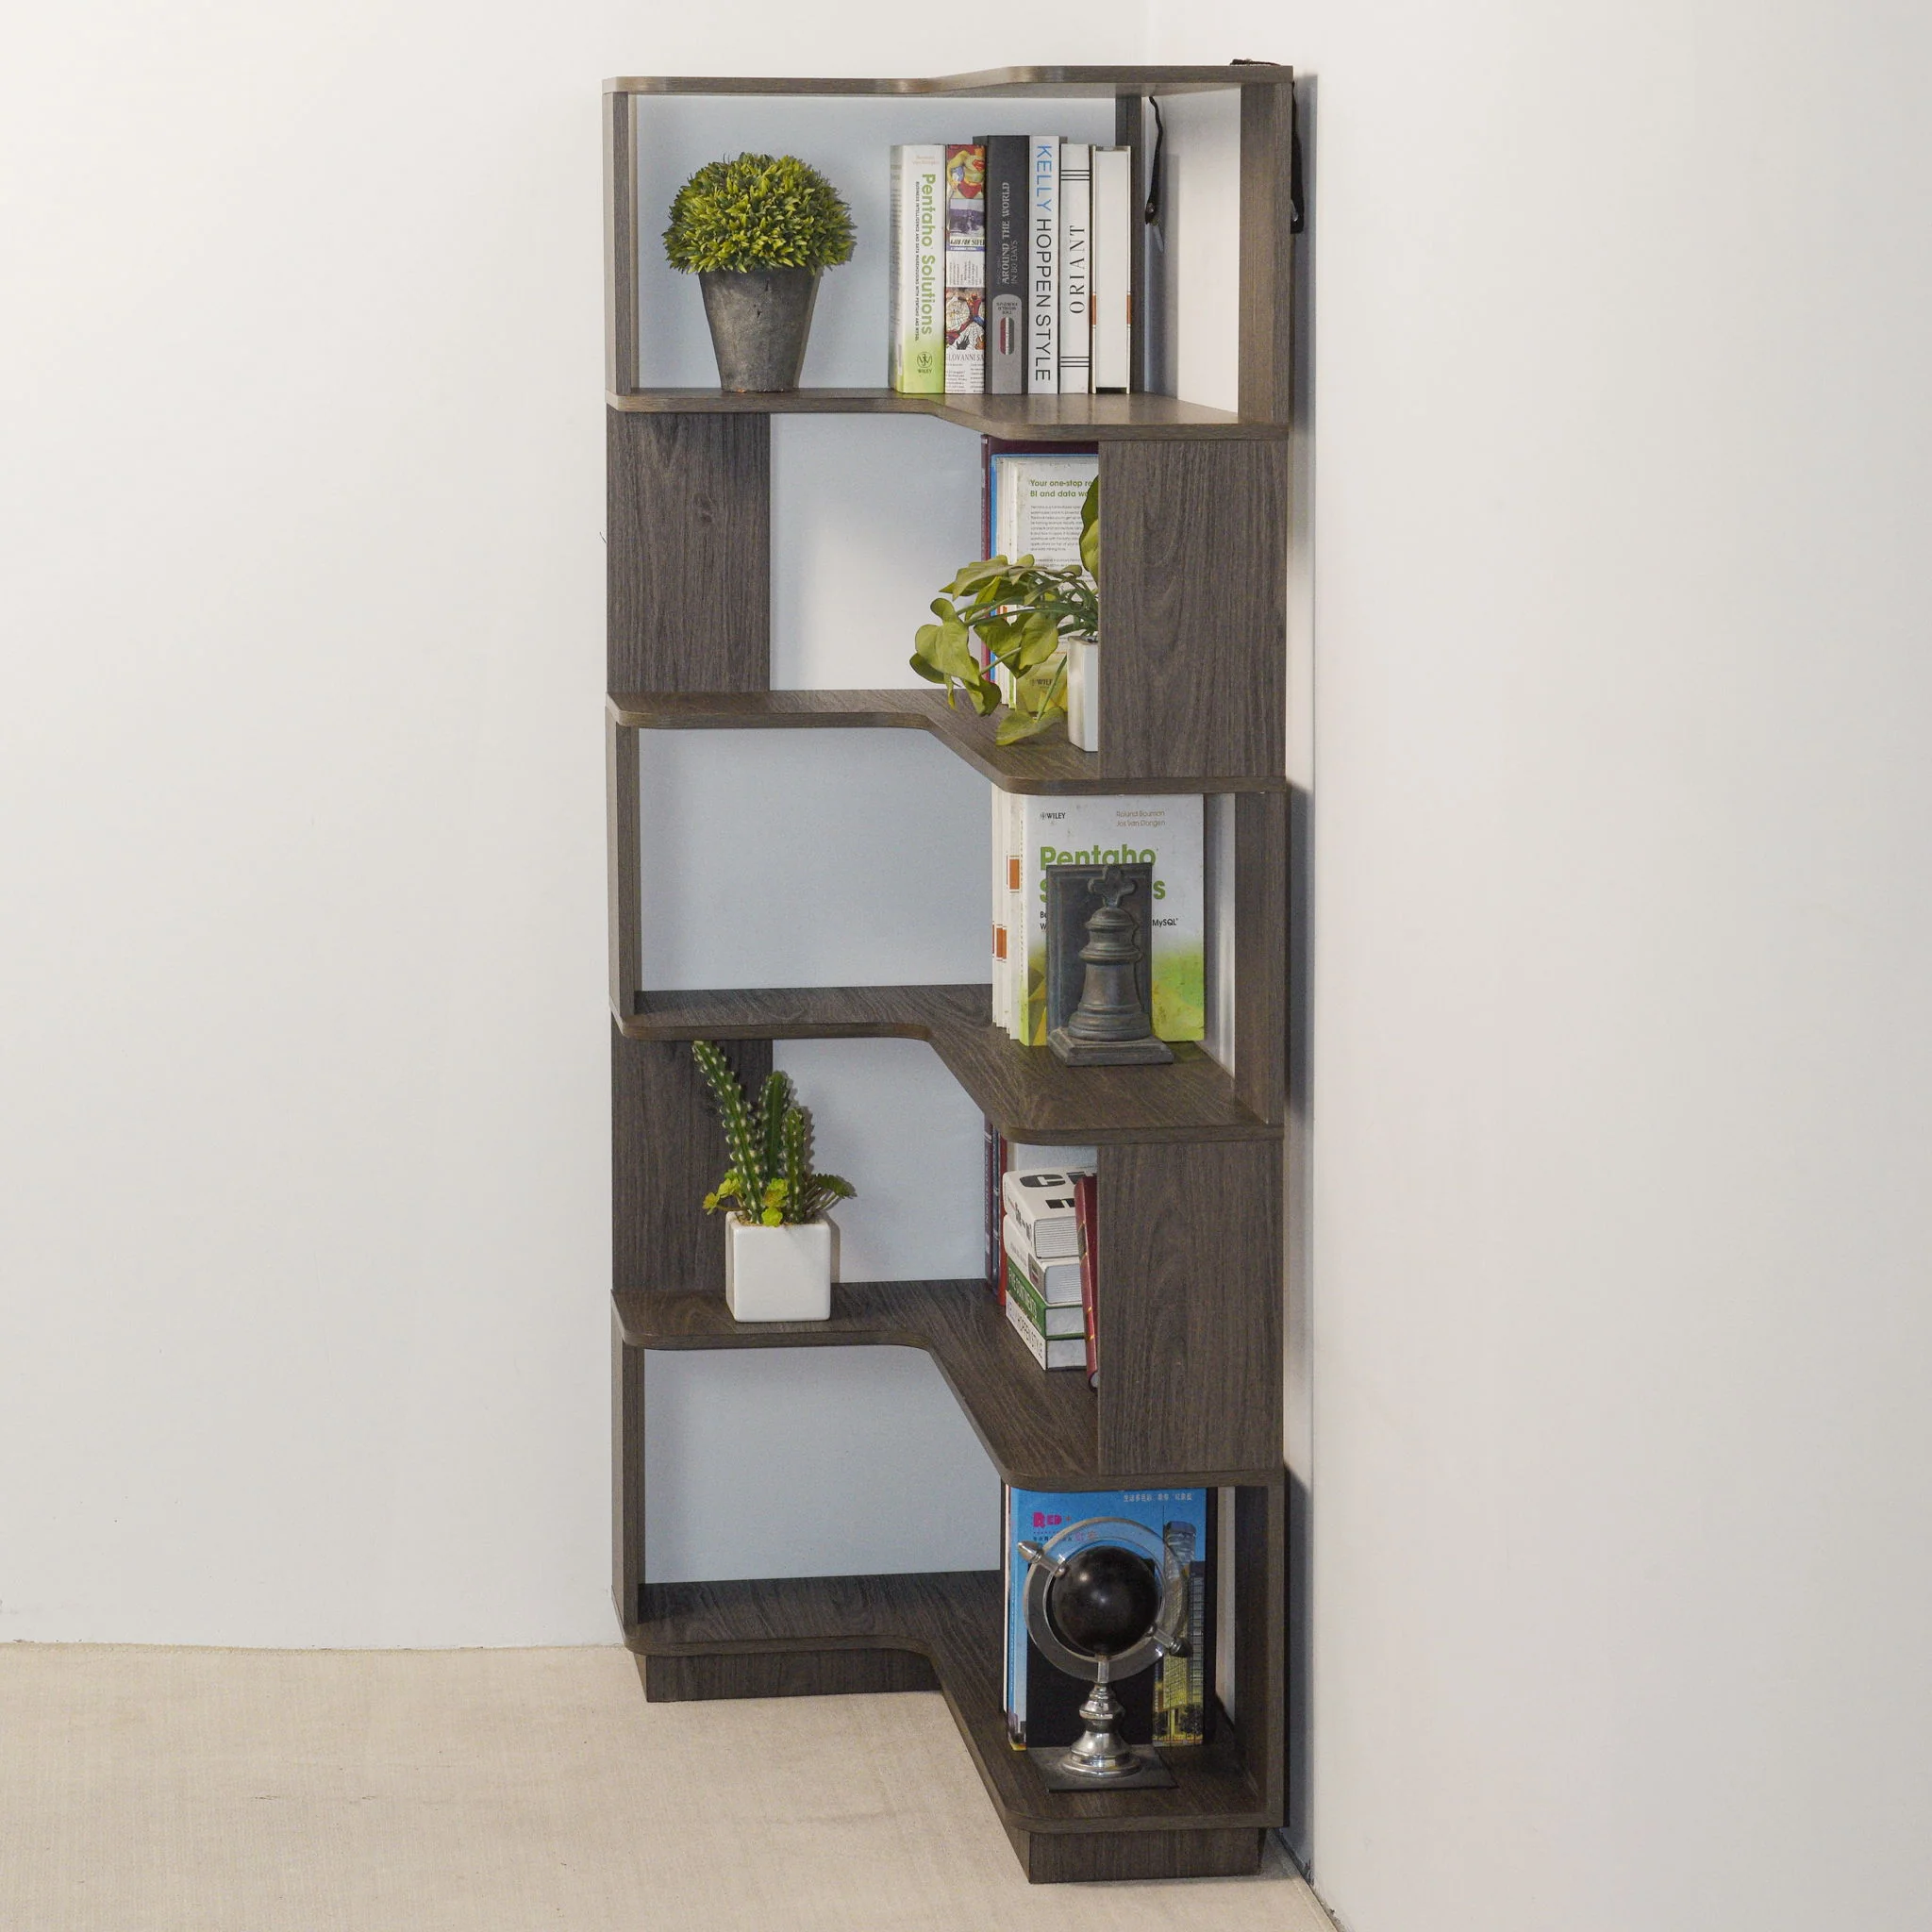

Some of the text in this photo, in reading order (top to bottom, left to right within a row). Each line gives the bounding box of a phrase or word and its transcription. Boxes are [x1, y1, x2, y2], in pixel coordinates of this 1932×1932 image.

[922, 174, 936, 247] Pentaho
[1001, 182, 1010, 284] AROUND THE WORLD
[922, 255, 936, 335] Solutions
[1010, 275, 1018, 284] IN
[1035, 145, 1052, 381] KELLY HOPPEN STYLE
[1069, 225, 1085, 314] ORIANT
[1049, 479, 1083, 488] one-stop
[1040, 844, 1157, 871] Pentaho
[1152, 919, 1177, 927] MySQL
